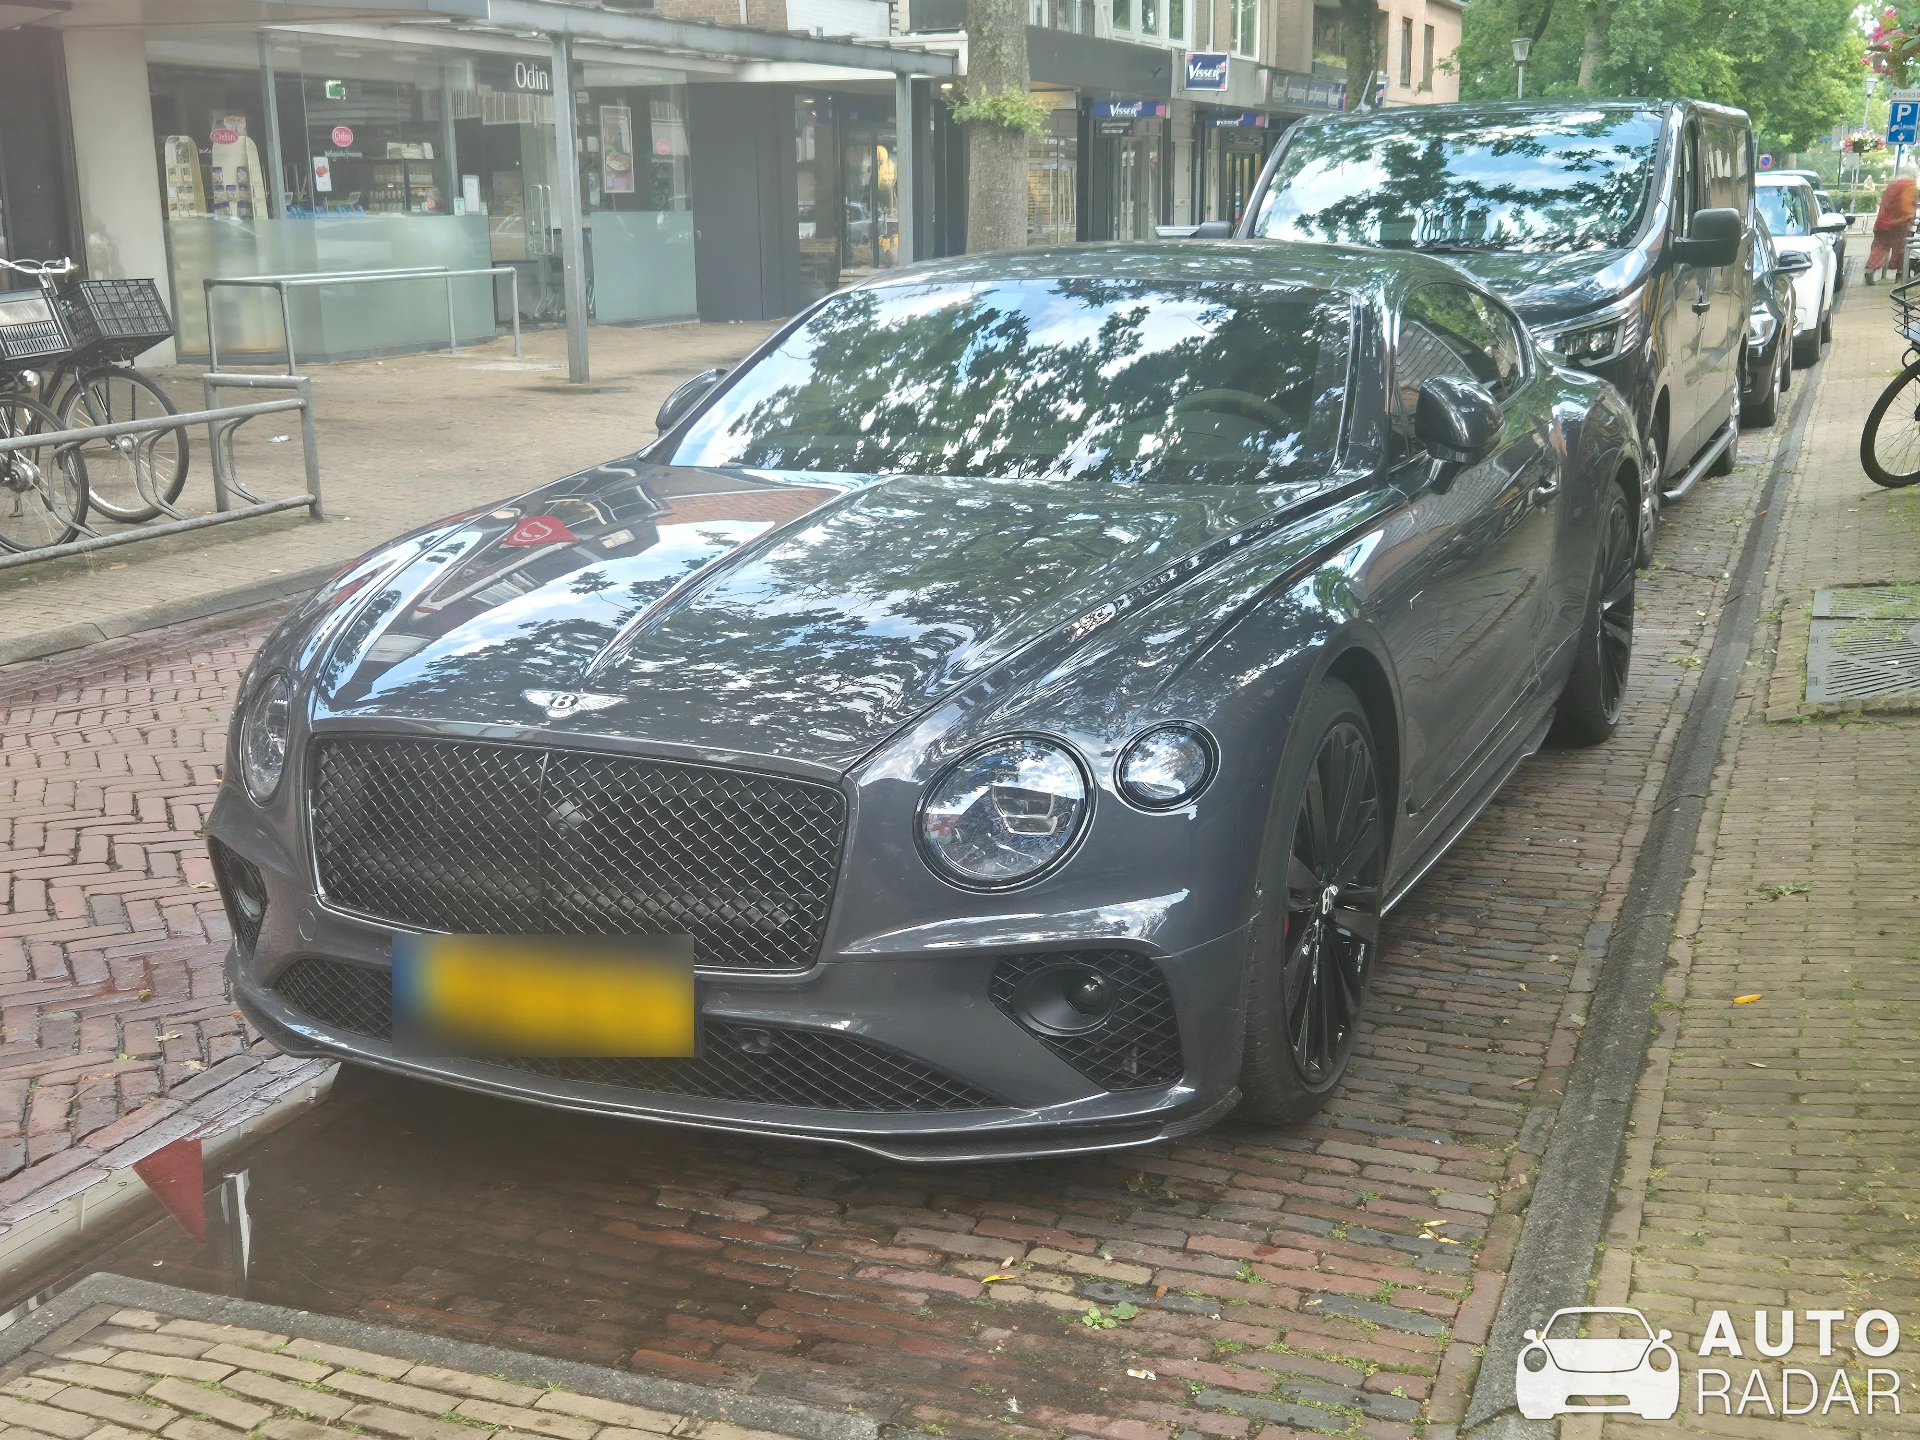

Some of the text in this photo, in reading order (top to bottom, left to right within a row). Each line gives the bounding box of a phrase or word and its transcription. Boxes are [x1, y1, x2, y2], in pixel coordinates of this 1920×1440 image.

[515, 62, 548, 90] Odin
[1897, 104, 1911, 122] P
[213, 133, 236, 142] Odin
